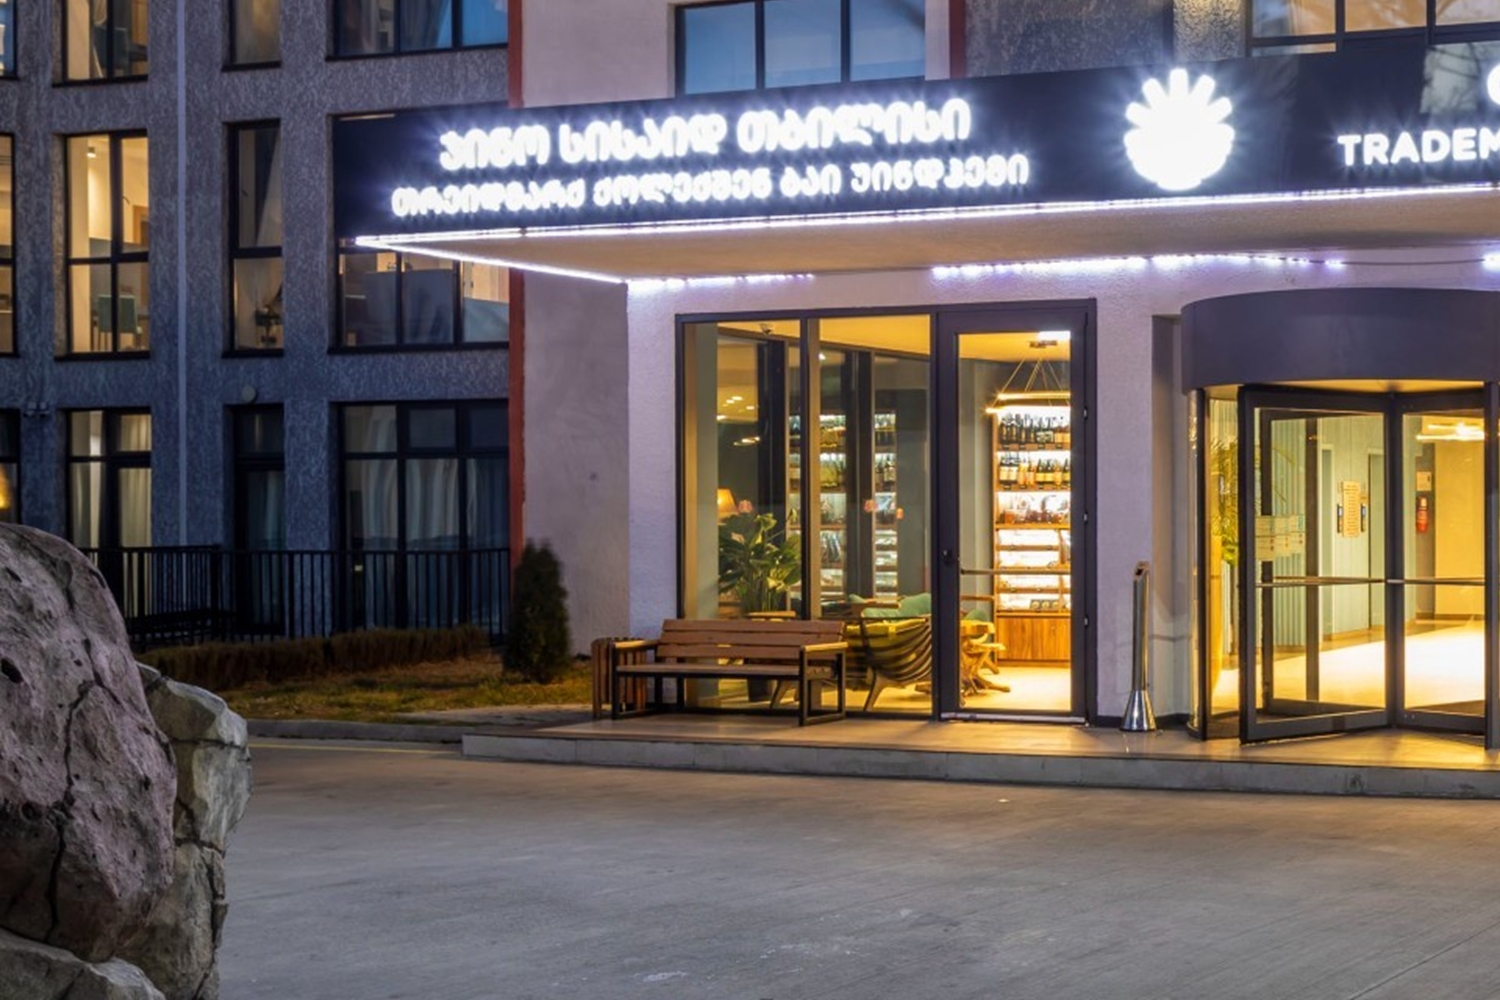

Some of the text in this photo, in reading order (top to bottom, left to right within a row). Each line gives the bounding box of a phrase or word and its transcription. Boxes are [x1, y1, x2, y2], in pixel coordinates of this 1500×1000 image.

[440, 98, 971, 170] ჯინო სისაიდ თბილისი
[780, 164, 842, 197] ბაი
